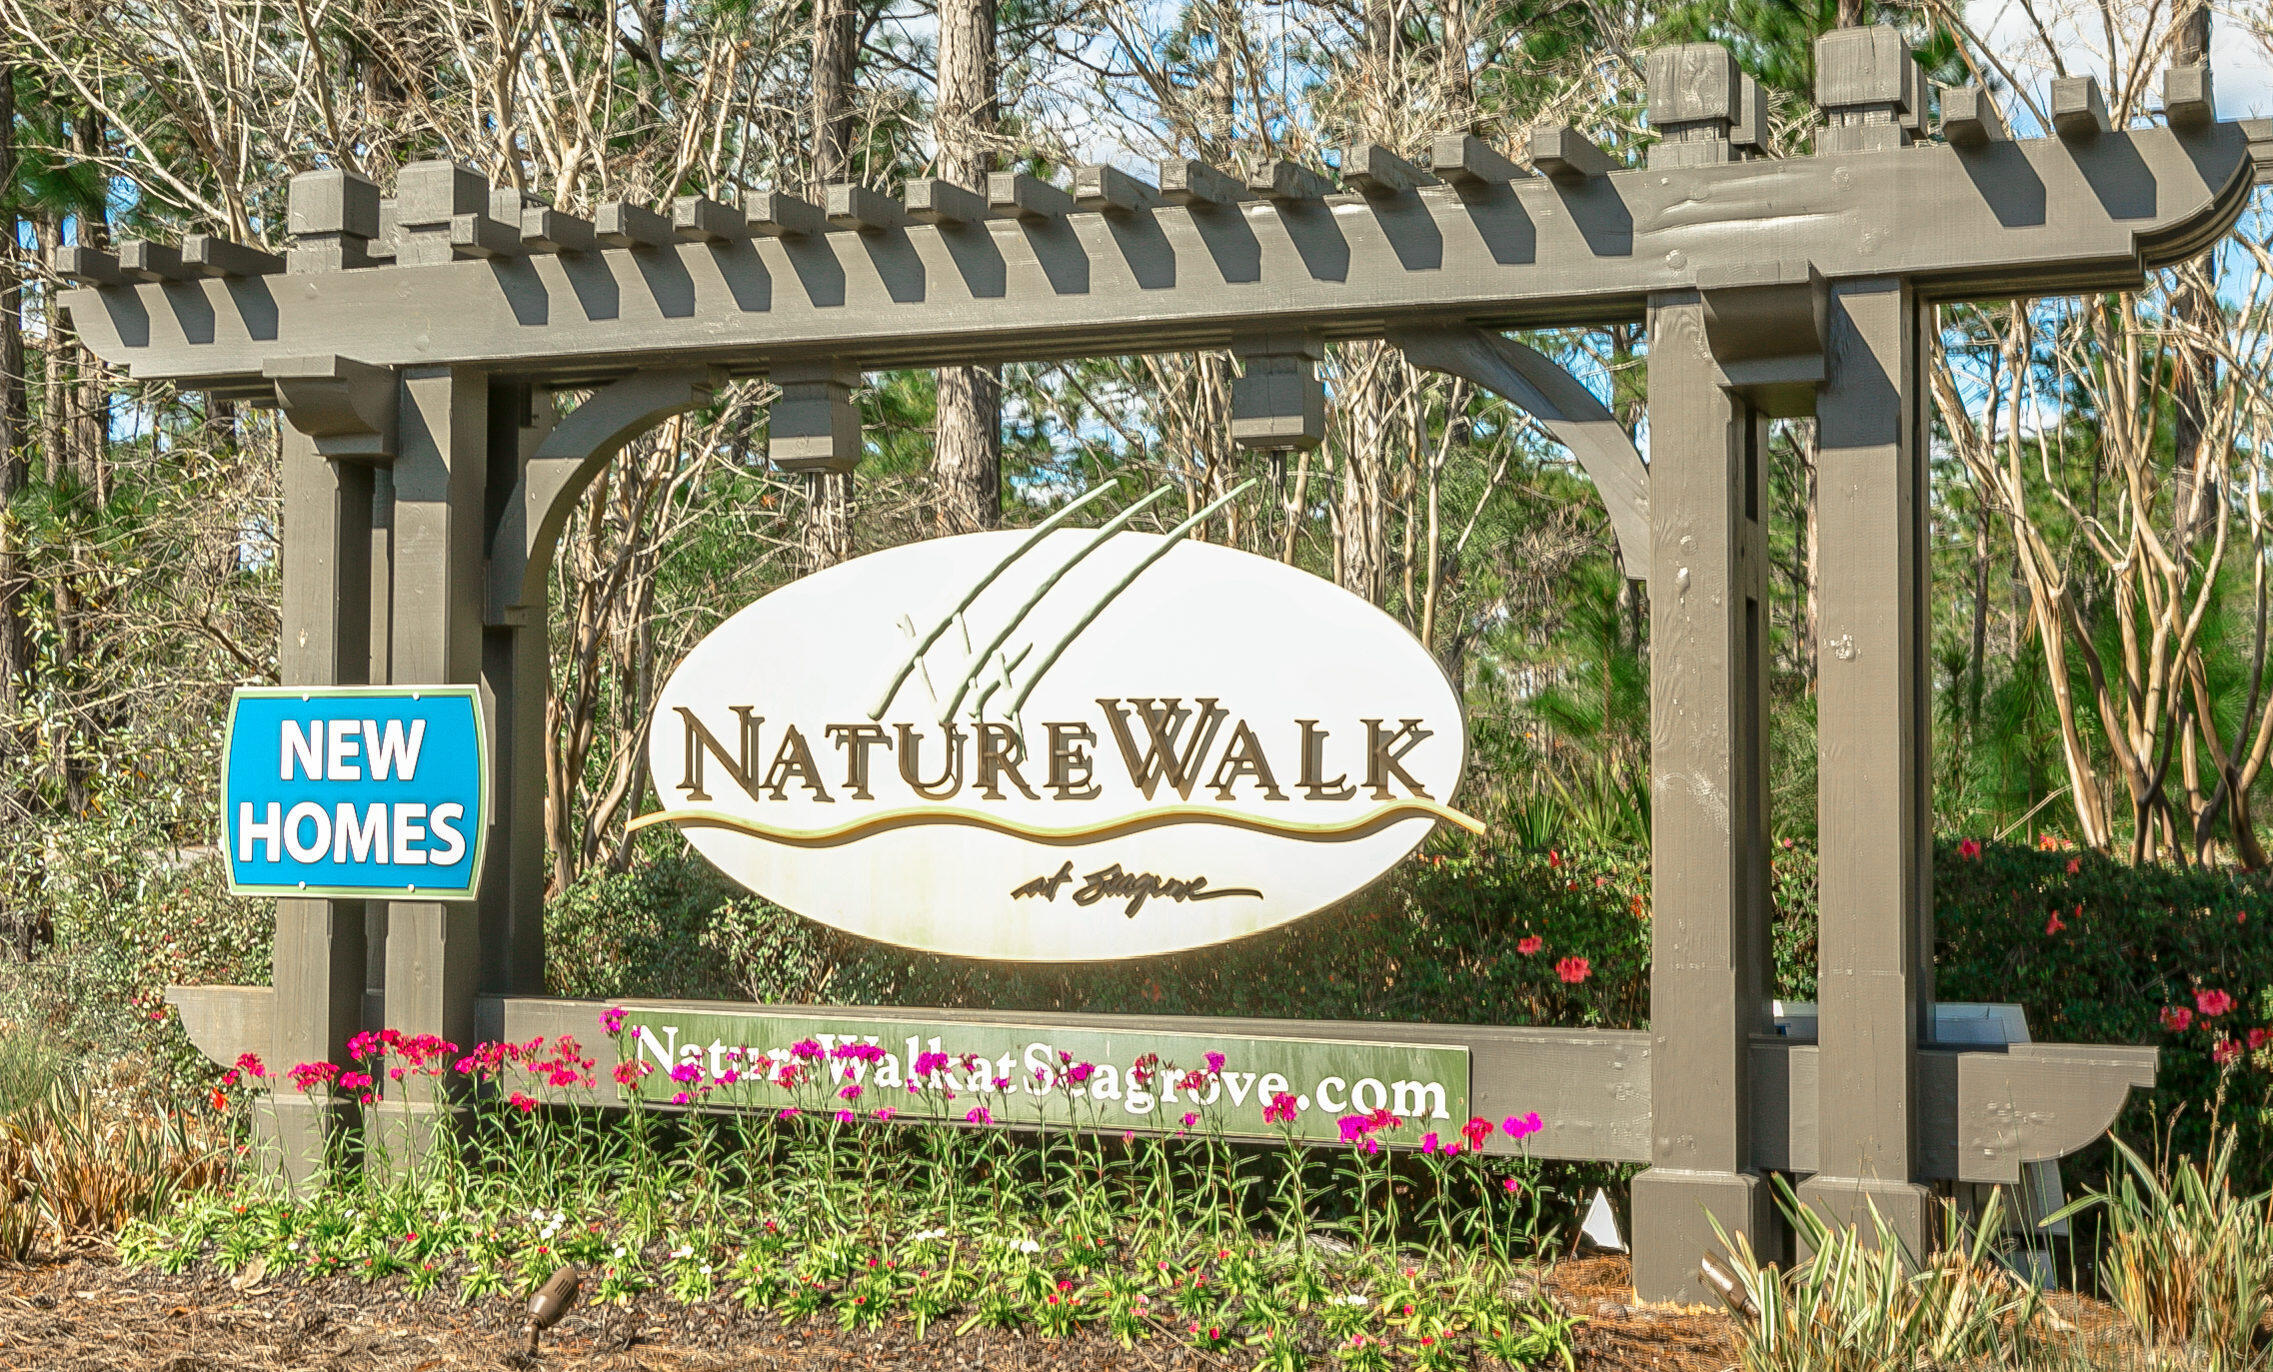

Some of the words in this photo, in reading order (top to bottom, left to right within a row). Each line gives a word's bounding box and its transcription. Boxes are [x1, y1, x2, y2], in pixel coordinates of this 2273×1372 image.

[280, 718, 427, 782] NEW
[239, 801, 467, 866] HOMES
[1010, 860, 1074, 903] at
